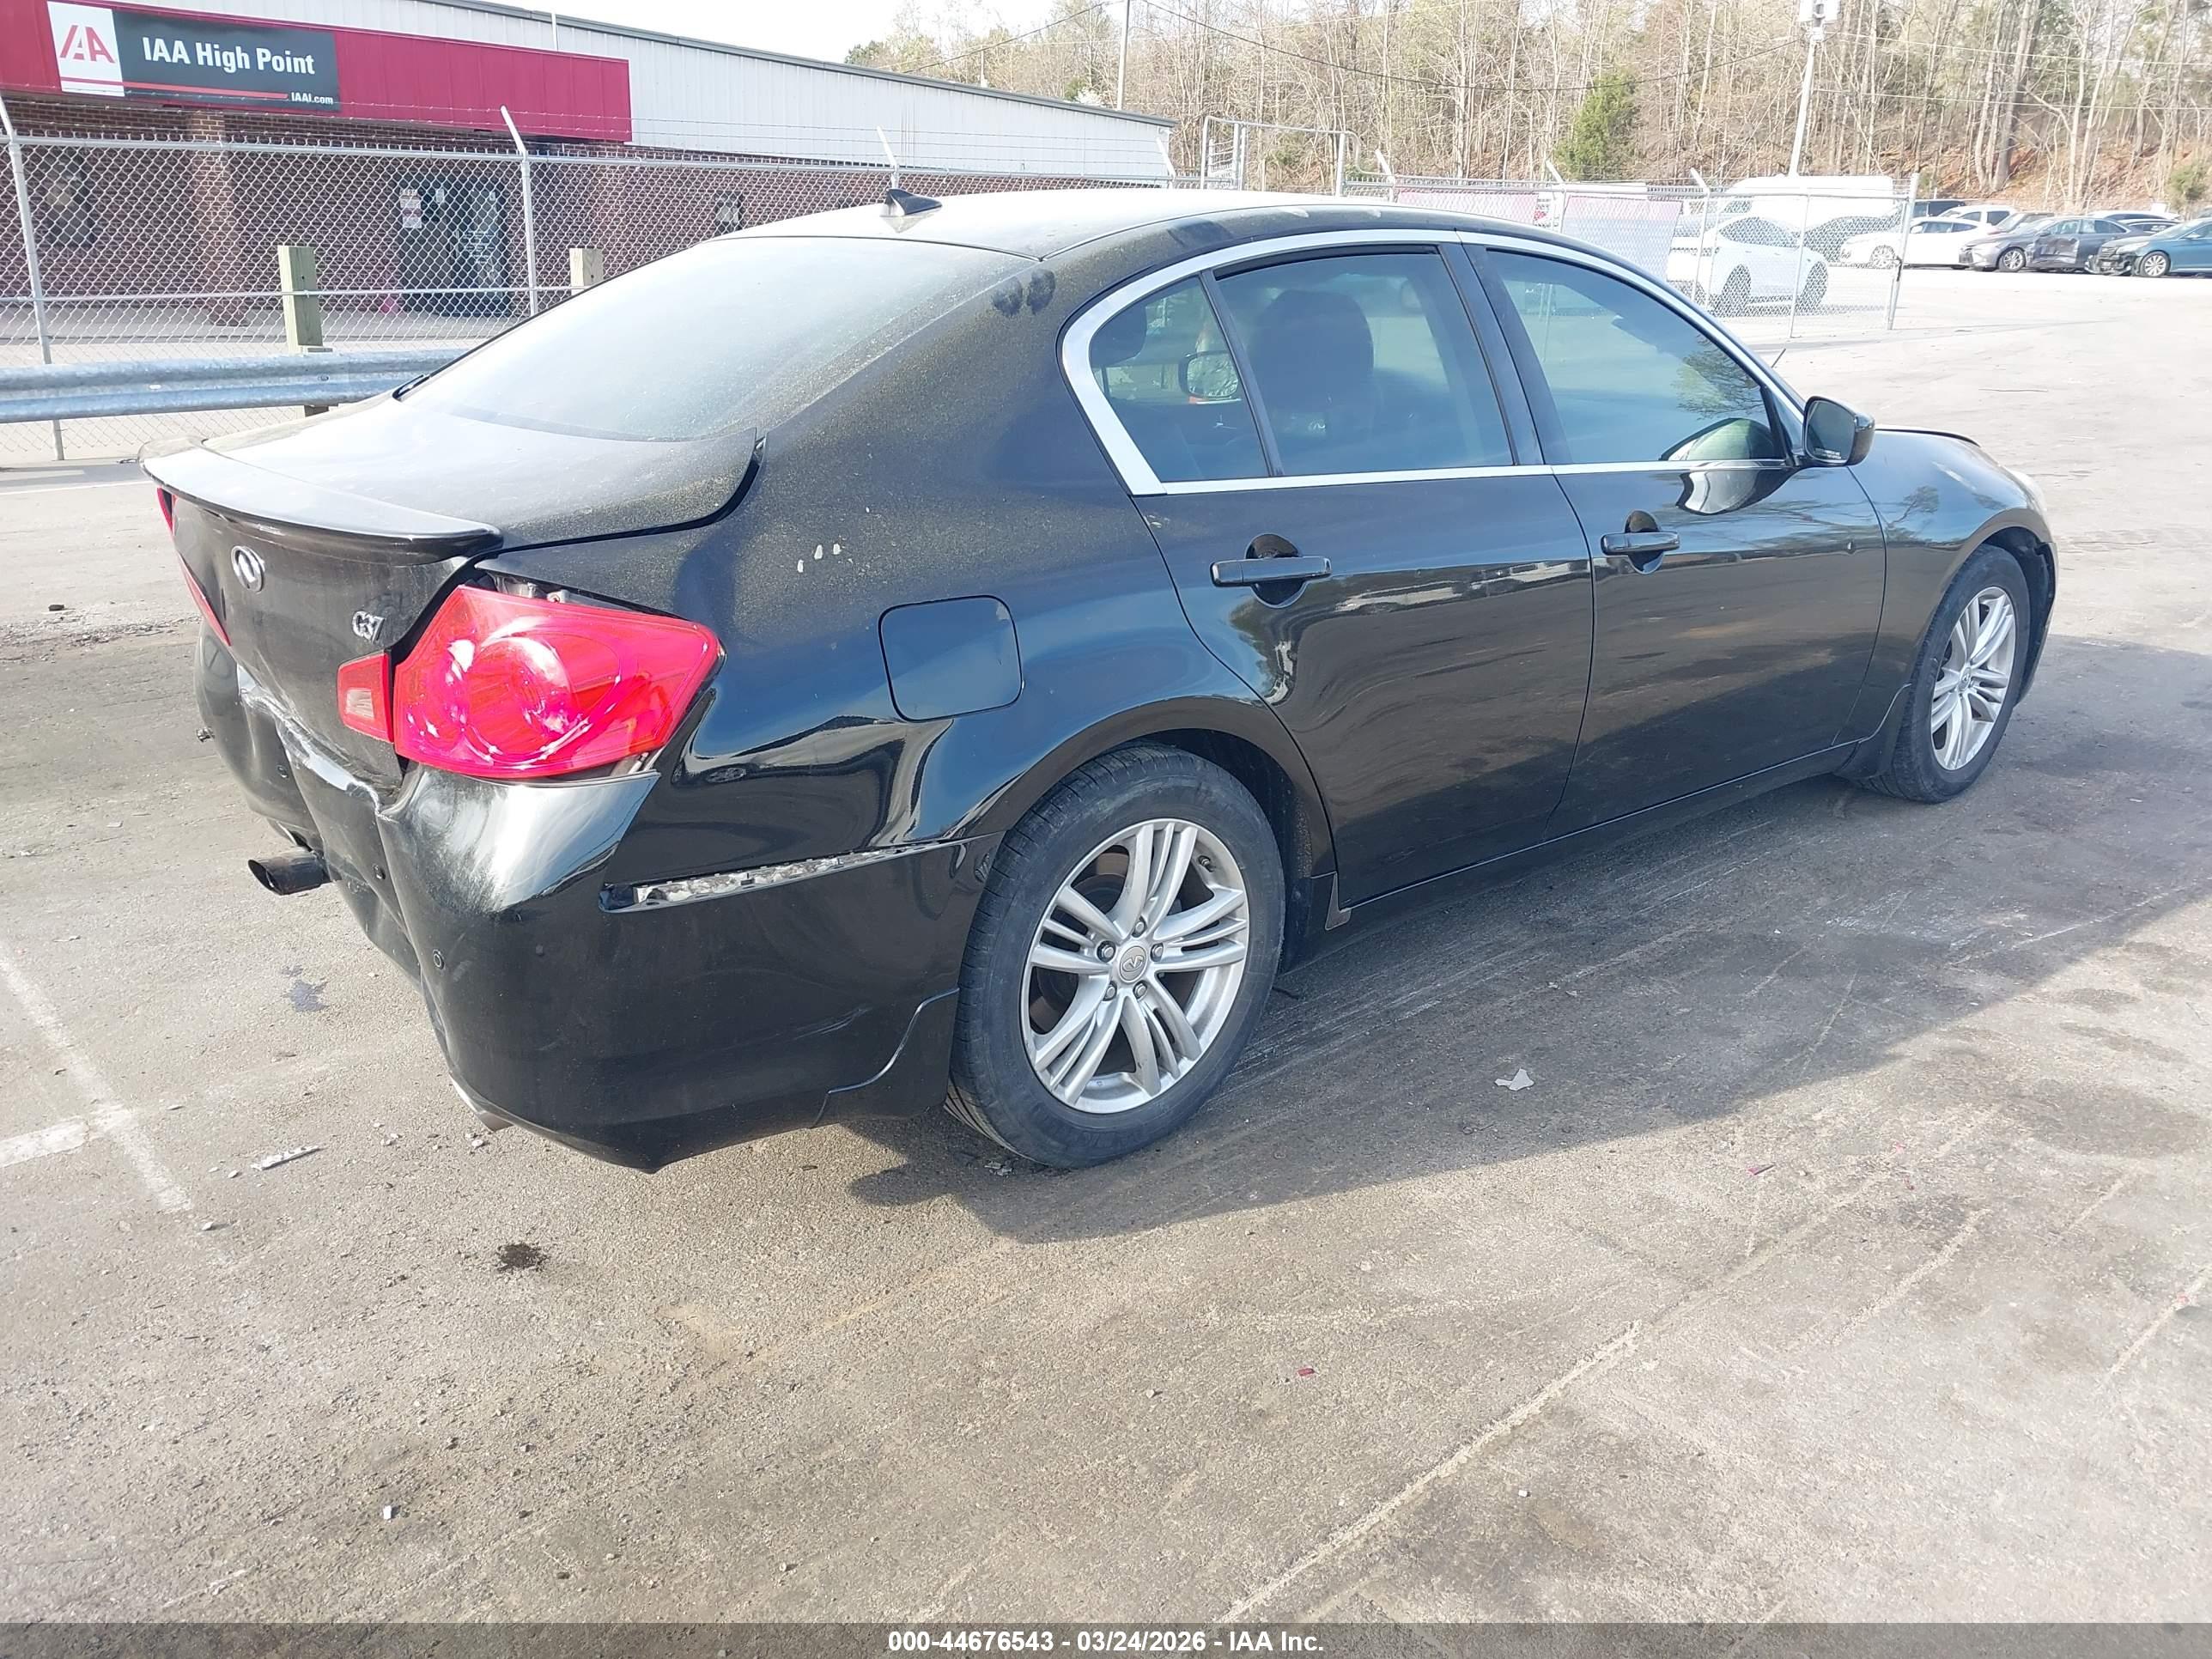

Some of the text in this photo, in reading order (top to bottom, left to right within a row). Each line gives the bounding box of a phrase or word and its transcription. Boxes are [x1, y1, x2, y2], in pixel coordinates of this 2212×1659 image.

[142, 36, 316, 75] IAA High Point
[290, 91, 334, 105] IAAI.com
[352, 610, 386, 644] G37
